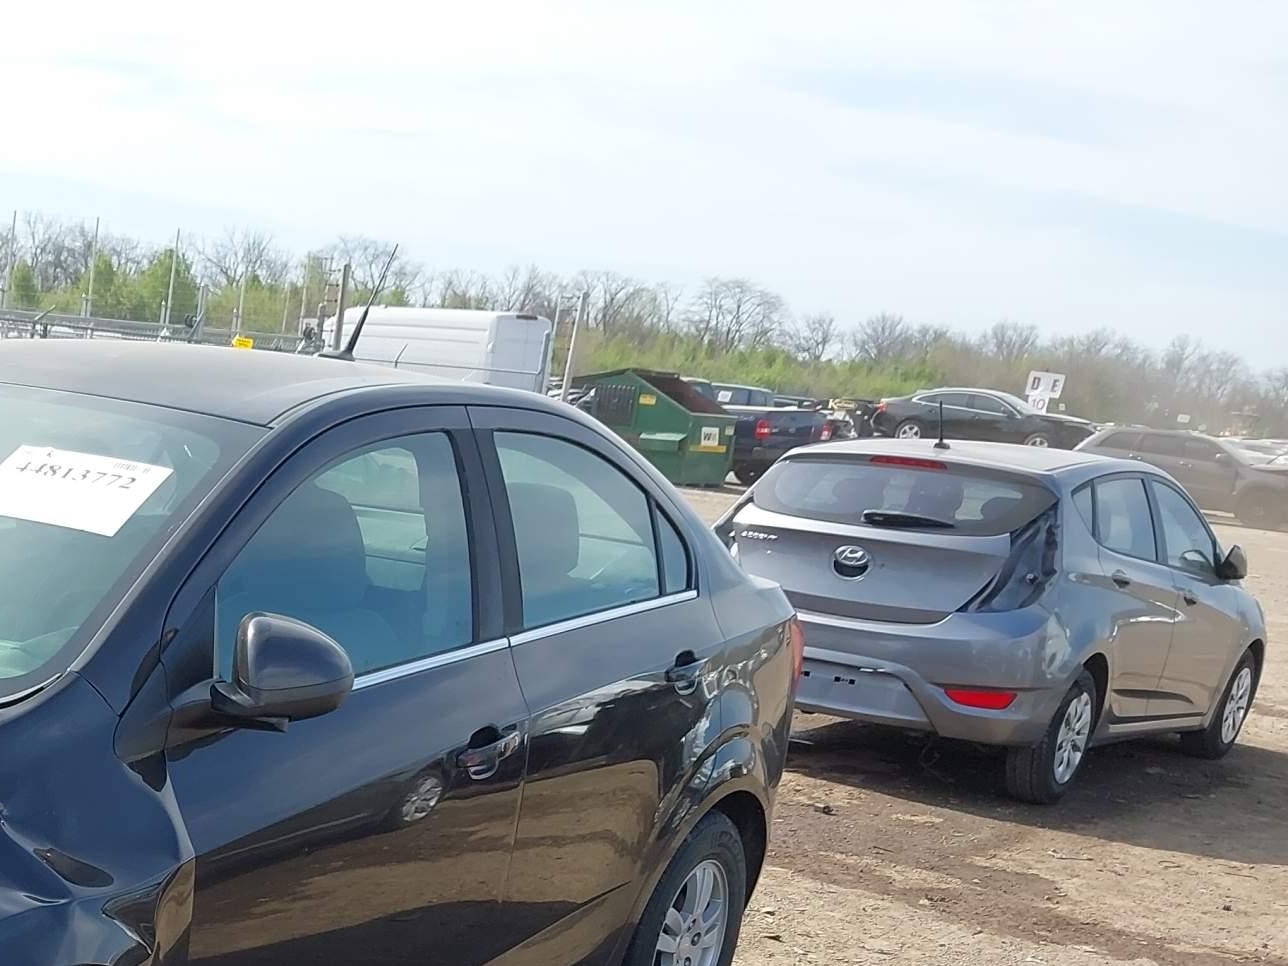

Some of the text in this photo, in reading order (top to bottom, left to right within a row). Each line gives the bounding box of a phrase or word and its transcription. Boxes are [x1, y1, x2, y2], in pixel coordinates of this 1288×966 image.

[1050, 379, 1060, 393] E
[1032, 398, 1046, 410] 10
[16, 461, 137, 489] 44813772
